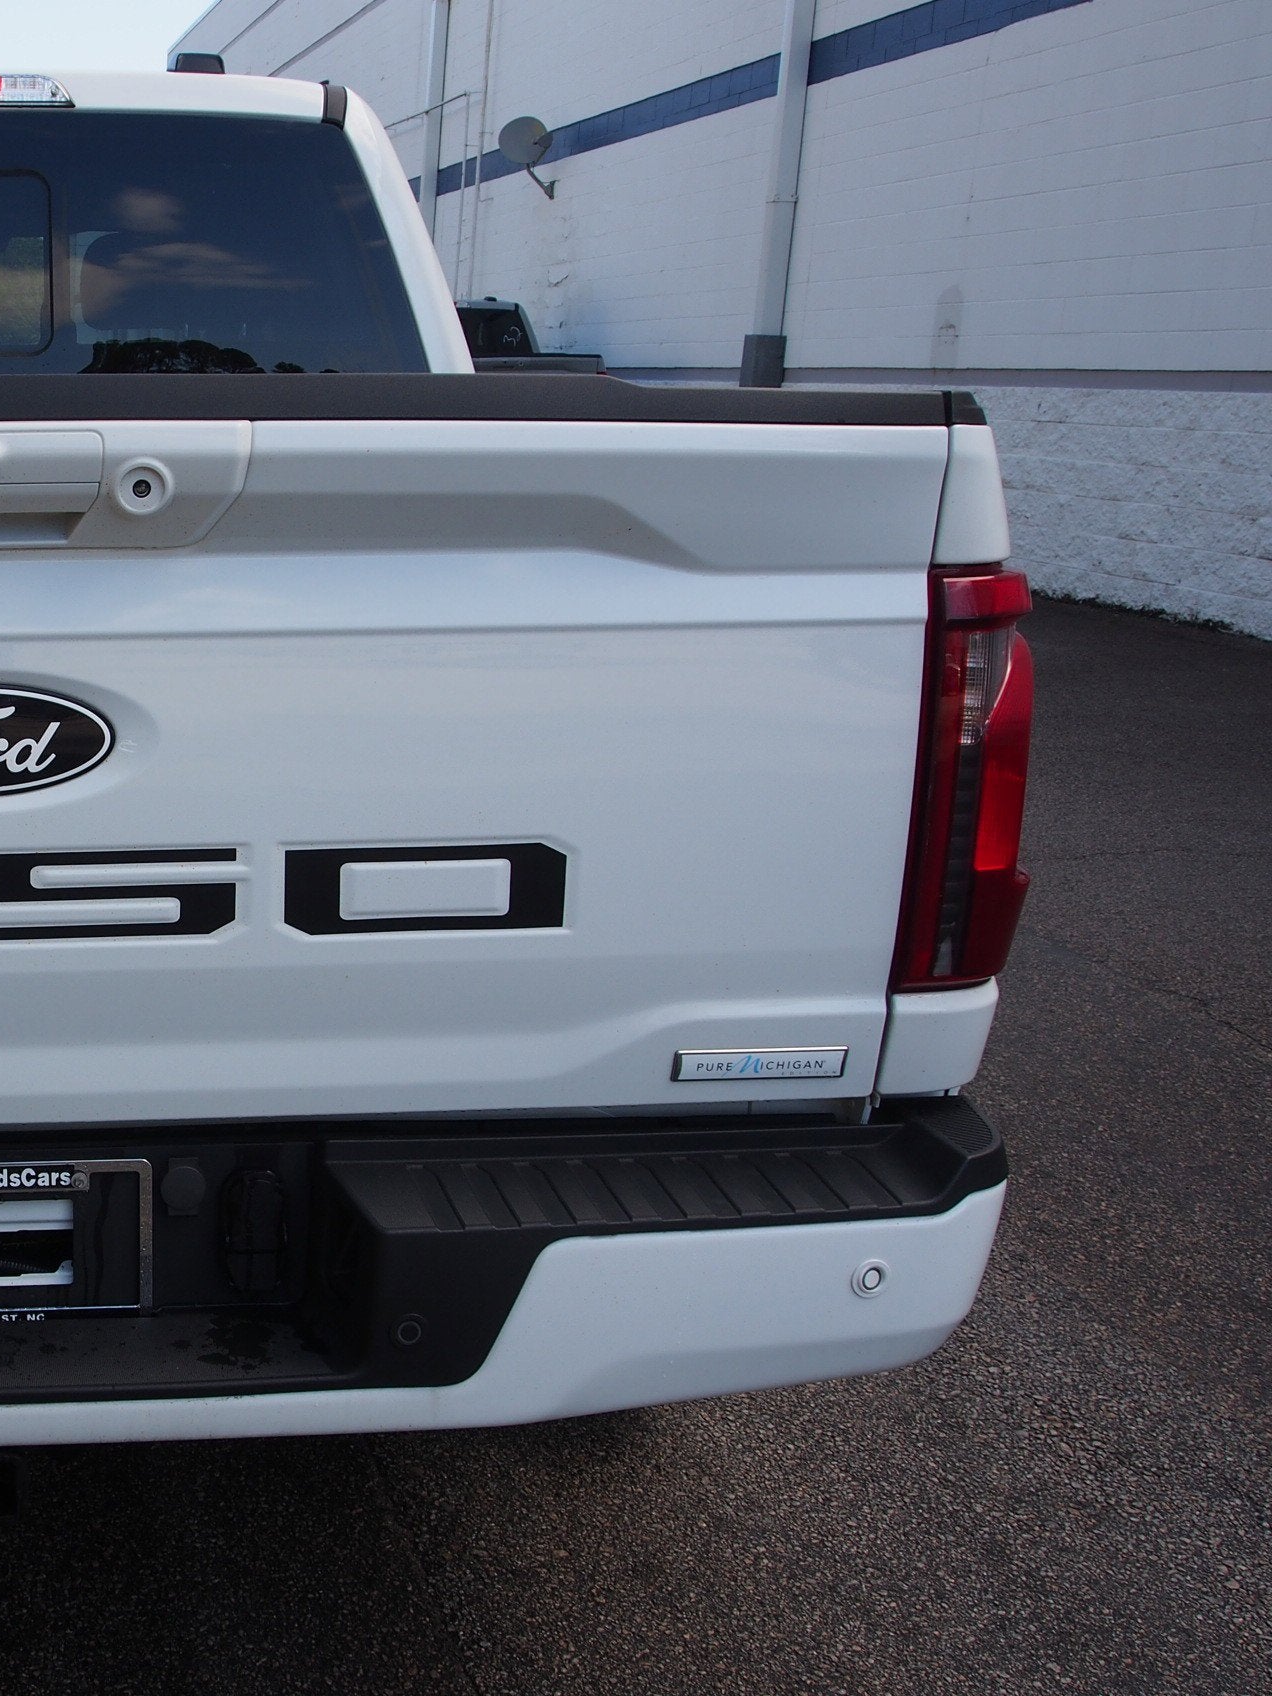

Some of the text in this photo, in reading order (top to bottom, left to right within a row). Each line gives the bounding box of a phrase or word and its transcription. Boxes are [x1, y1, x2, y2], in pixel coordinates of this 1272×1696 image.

[696, 1055, 824, 1077] PURE MICHIGAN
[27, 1313, 45, 1321] NC
